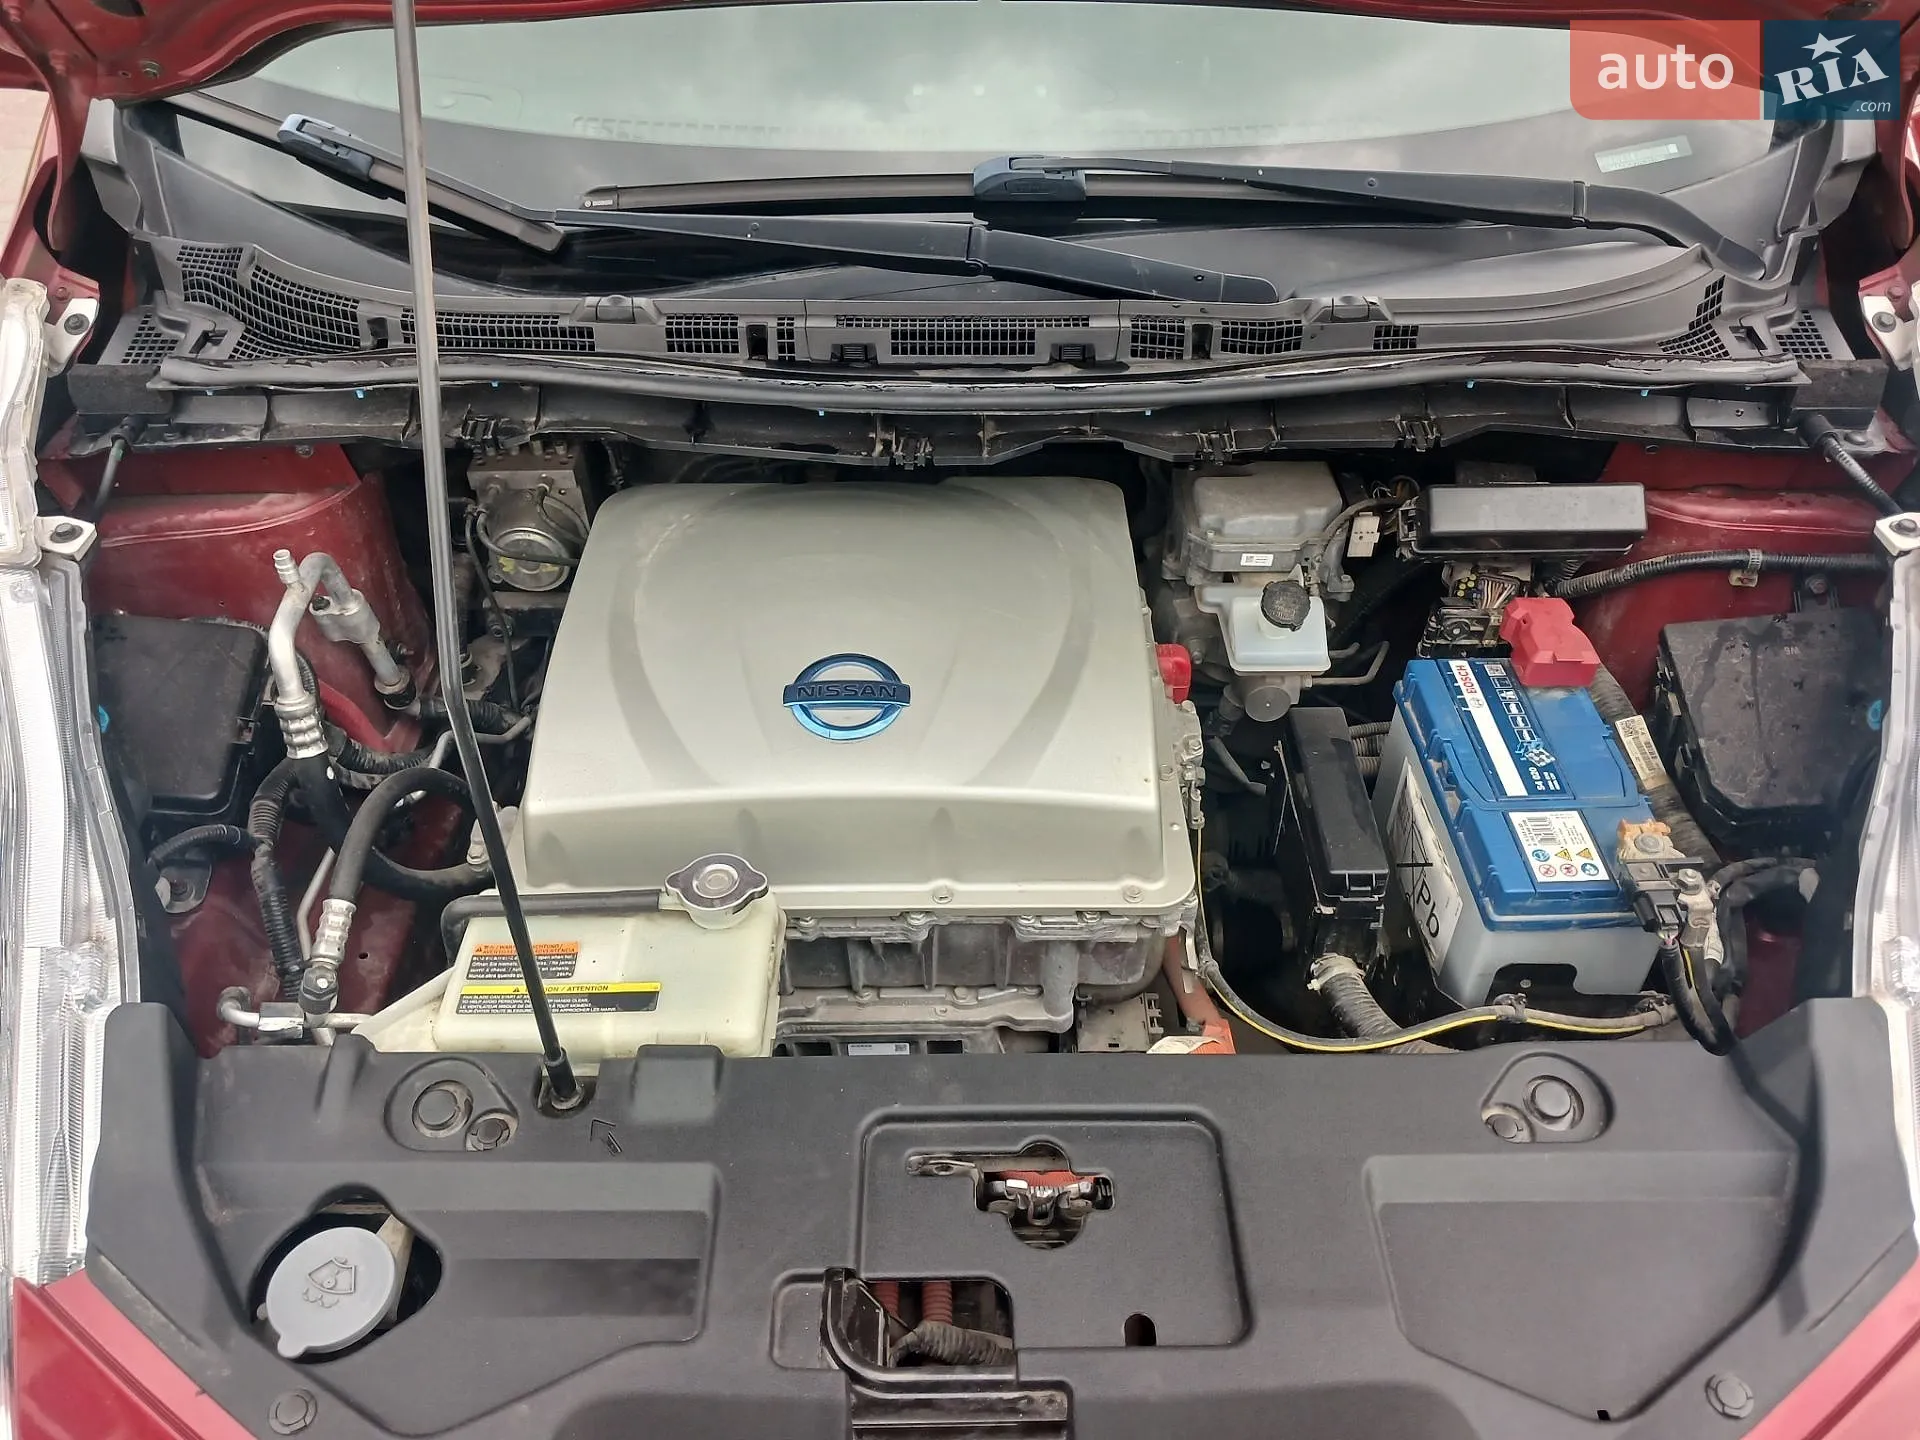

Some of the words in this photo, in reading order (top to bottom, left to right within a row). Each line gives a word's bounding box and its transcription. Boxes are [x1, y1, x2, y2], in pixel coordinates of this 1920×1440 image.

[797, 684, 897, 699] NISSAN
[1455, 665, 1477, 693] BOSCH
[1416, 878, 1440, 938] Pb
